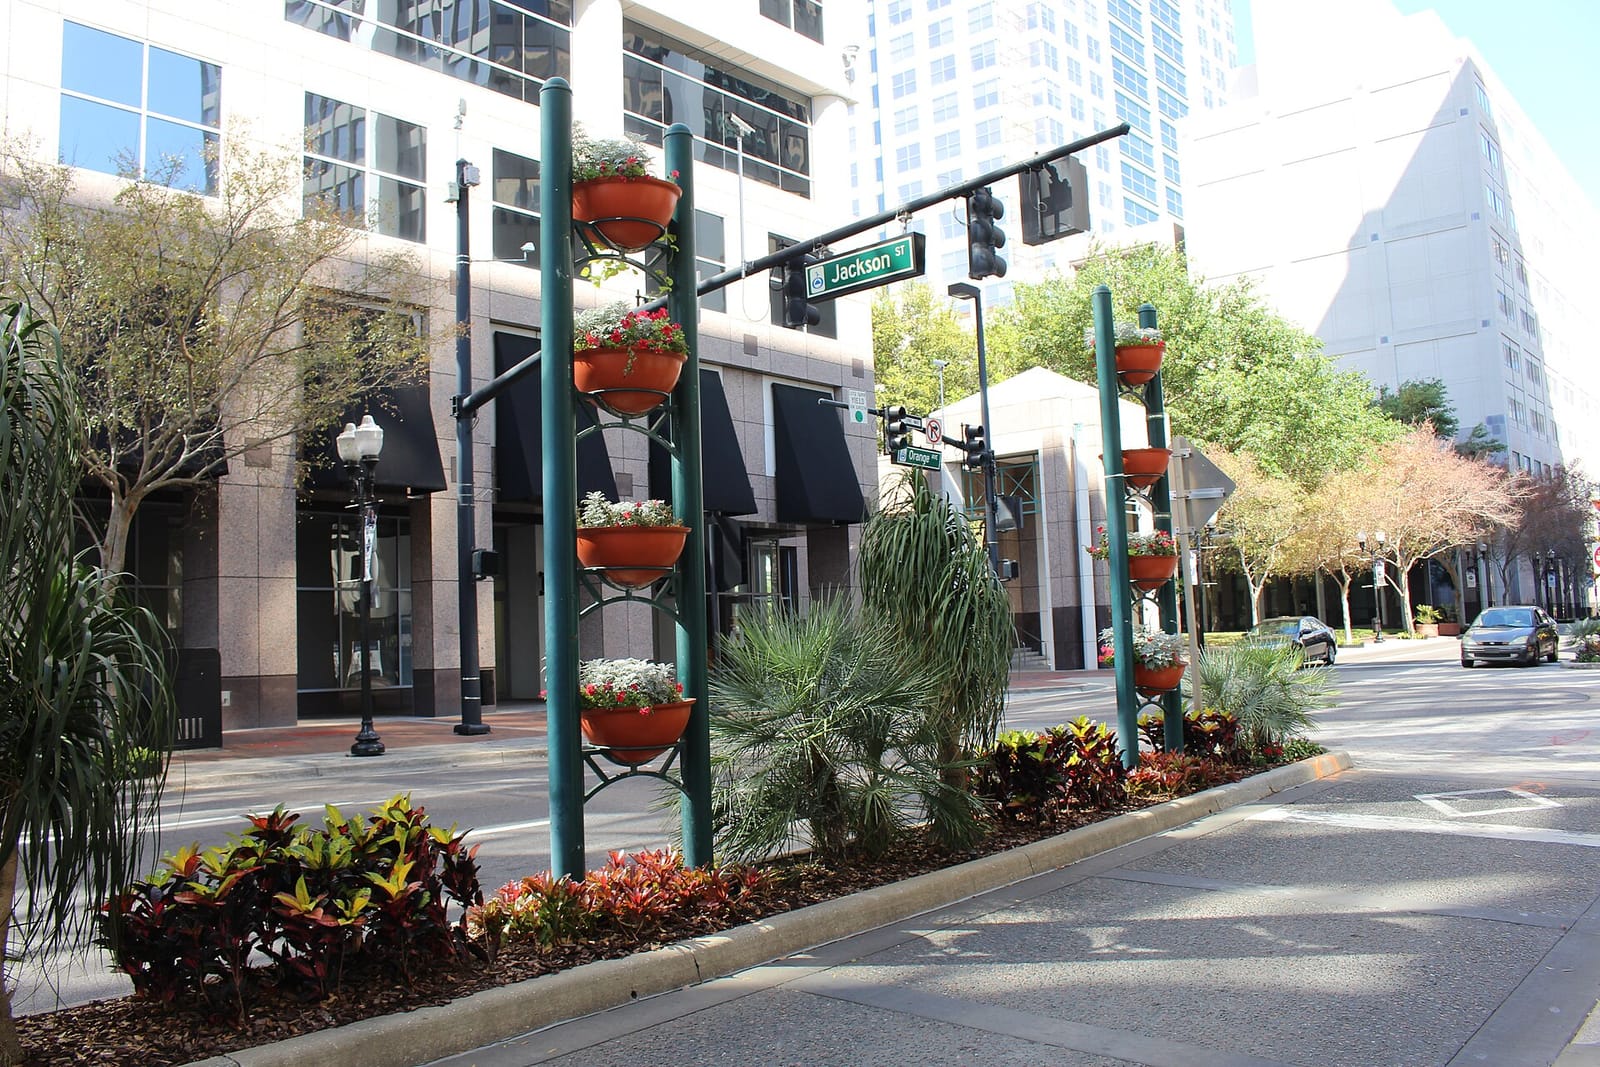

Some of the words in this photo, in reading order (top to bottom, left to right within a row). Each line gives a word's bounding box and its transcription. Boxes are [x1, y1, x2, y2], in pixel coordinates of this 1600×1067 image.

[831, 254, 890, 283] Jackson
[894, 245, 905, 256] ST
[908, 450, 930, 465] Orange
